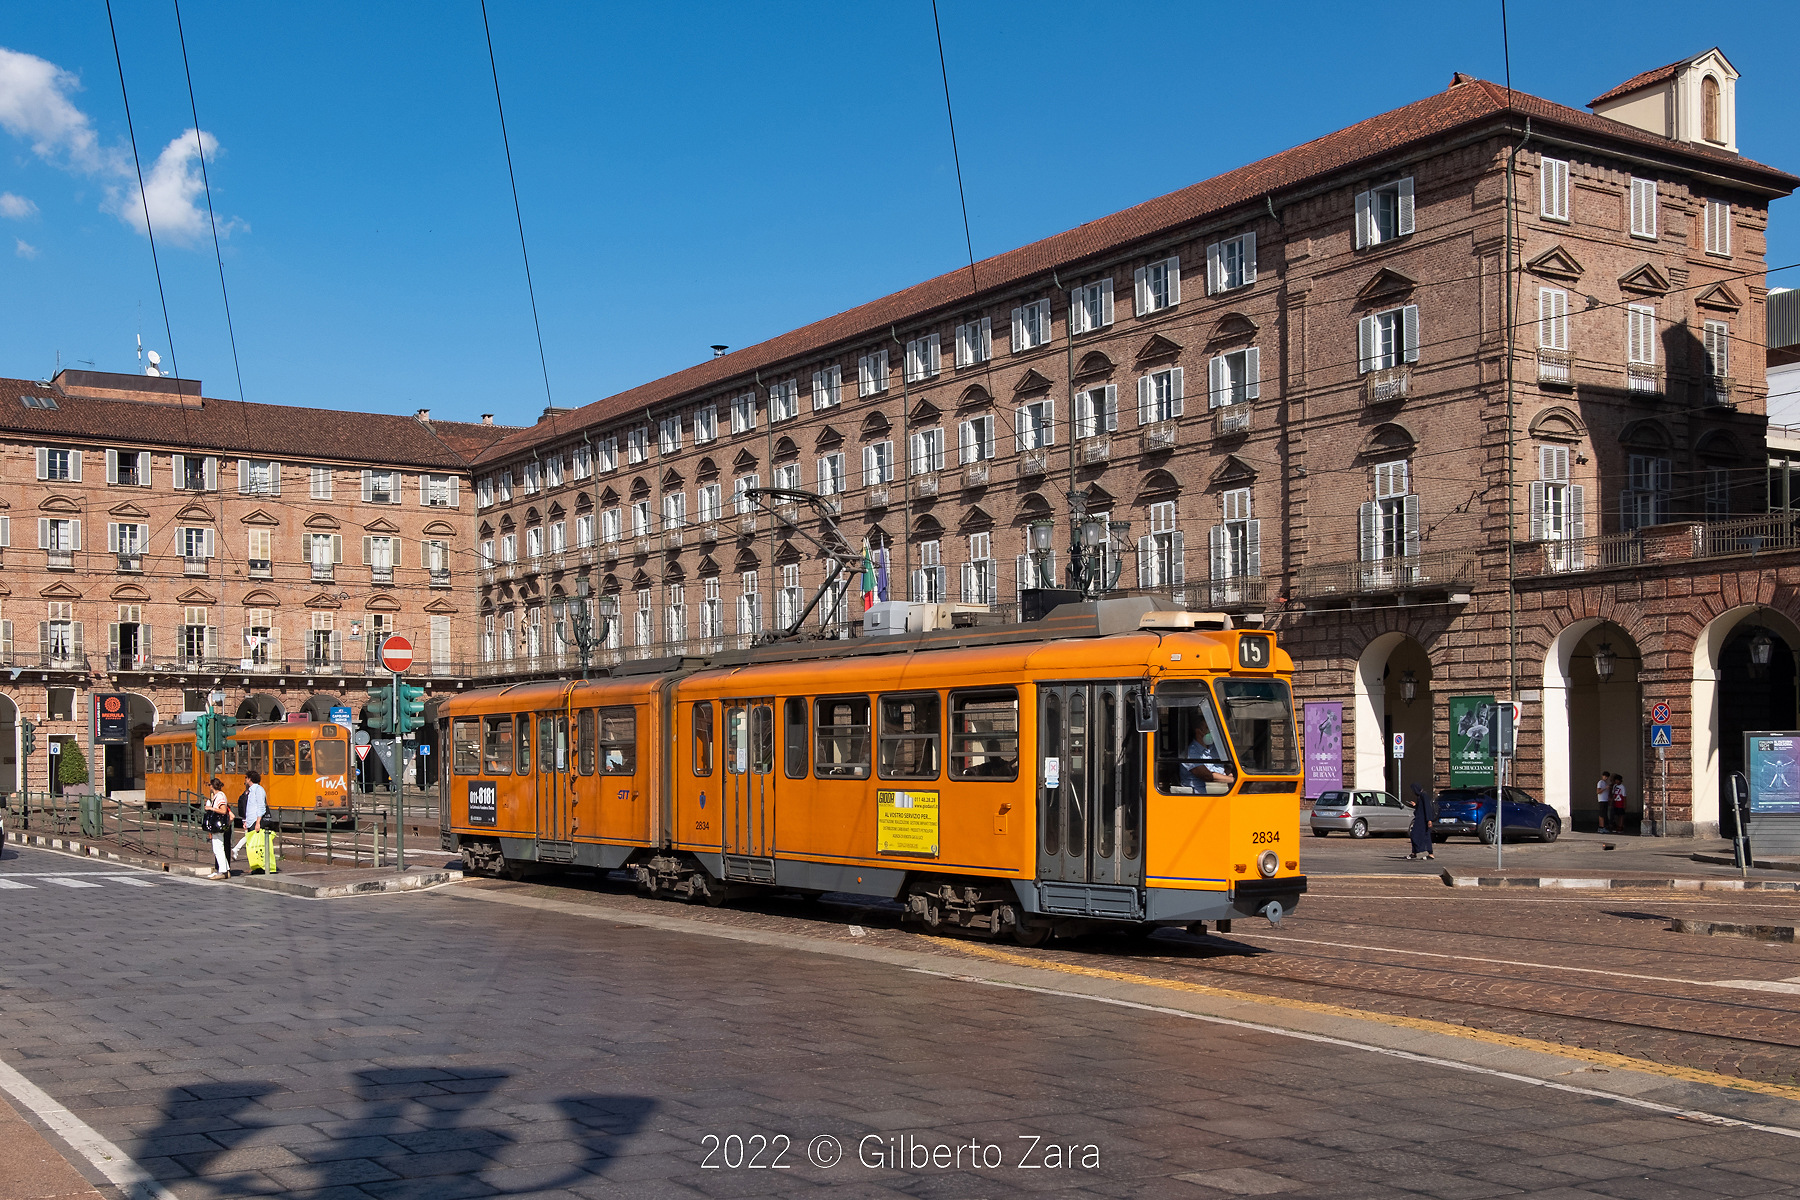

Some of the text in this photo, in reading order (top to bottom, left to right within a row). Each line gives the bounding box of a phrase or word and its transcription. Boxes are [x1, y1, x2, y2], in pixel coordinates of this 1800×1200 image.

[1241, 642, 1261, 662] 15
[324, 727, 335, 736] 15
[695, 821, 710, 830] 2834
[1252, 831, 1280, 844] 2834
